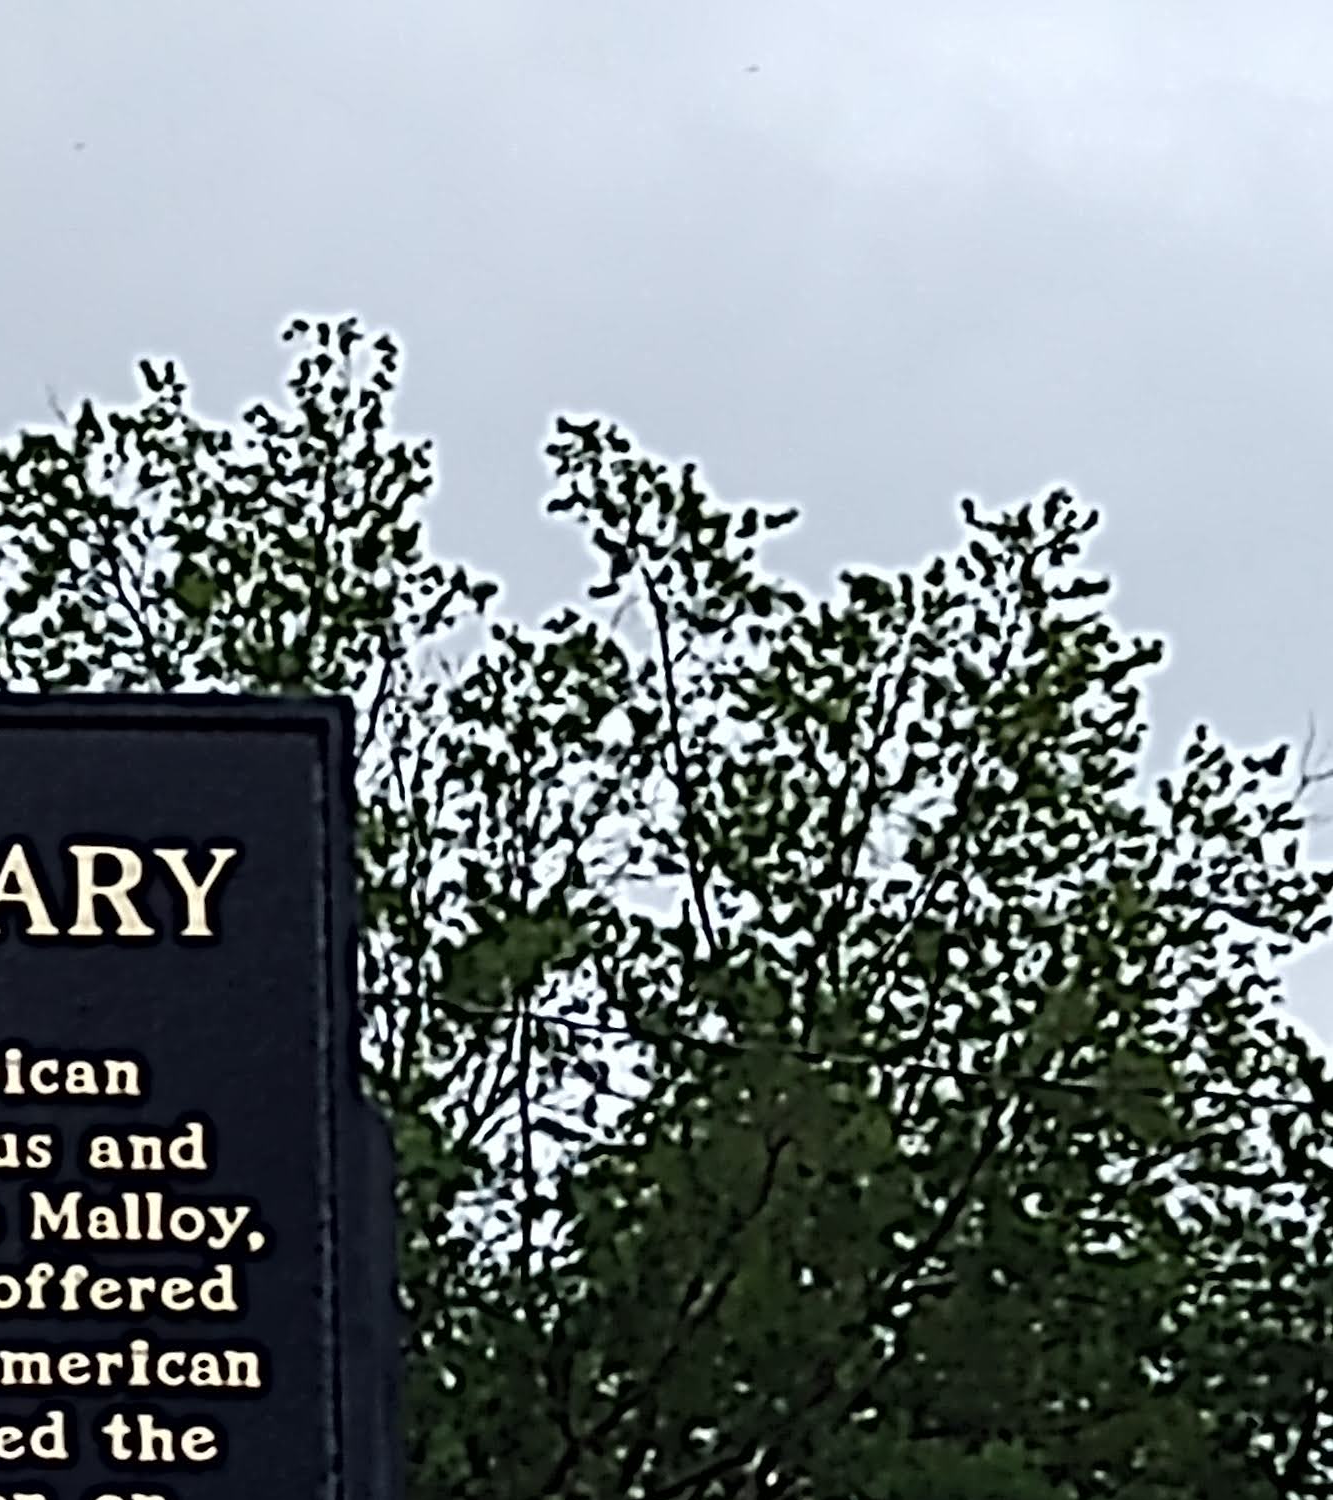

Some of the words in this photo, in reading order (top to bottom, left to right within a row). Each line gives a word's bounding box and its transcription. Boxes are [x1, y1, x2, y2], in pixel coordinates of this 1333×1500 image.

[88, 1121, 208, 1171] and
[29, 1190, 266, 1253] Malloy,
[100, 1412, 219, 1463] the
